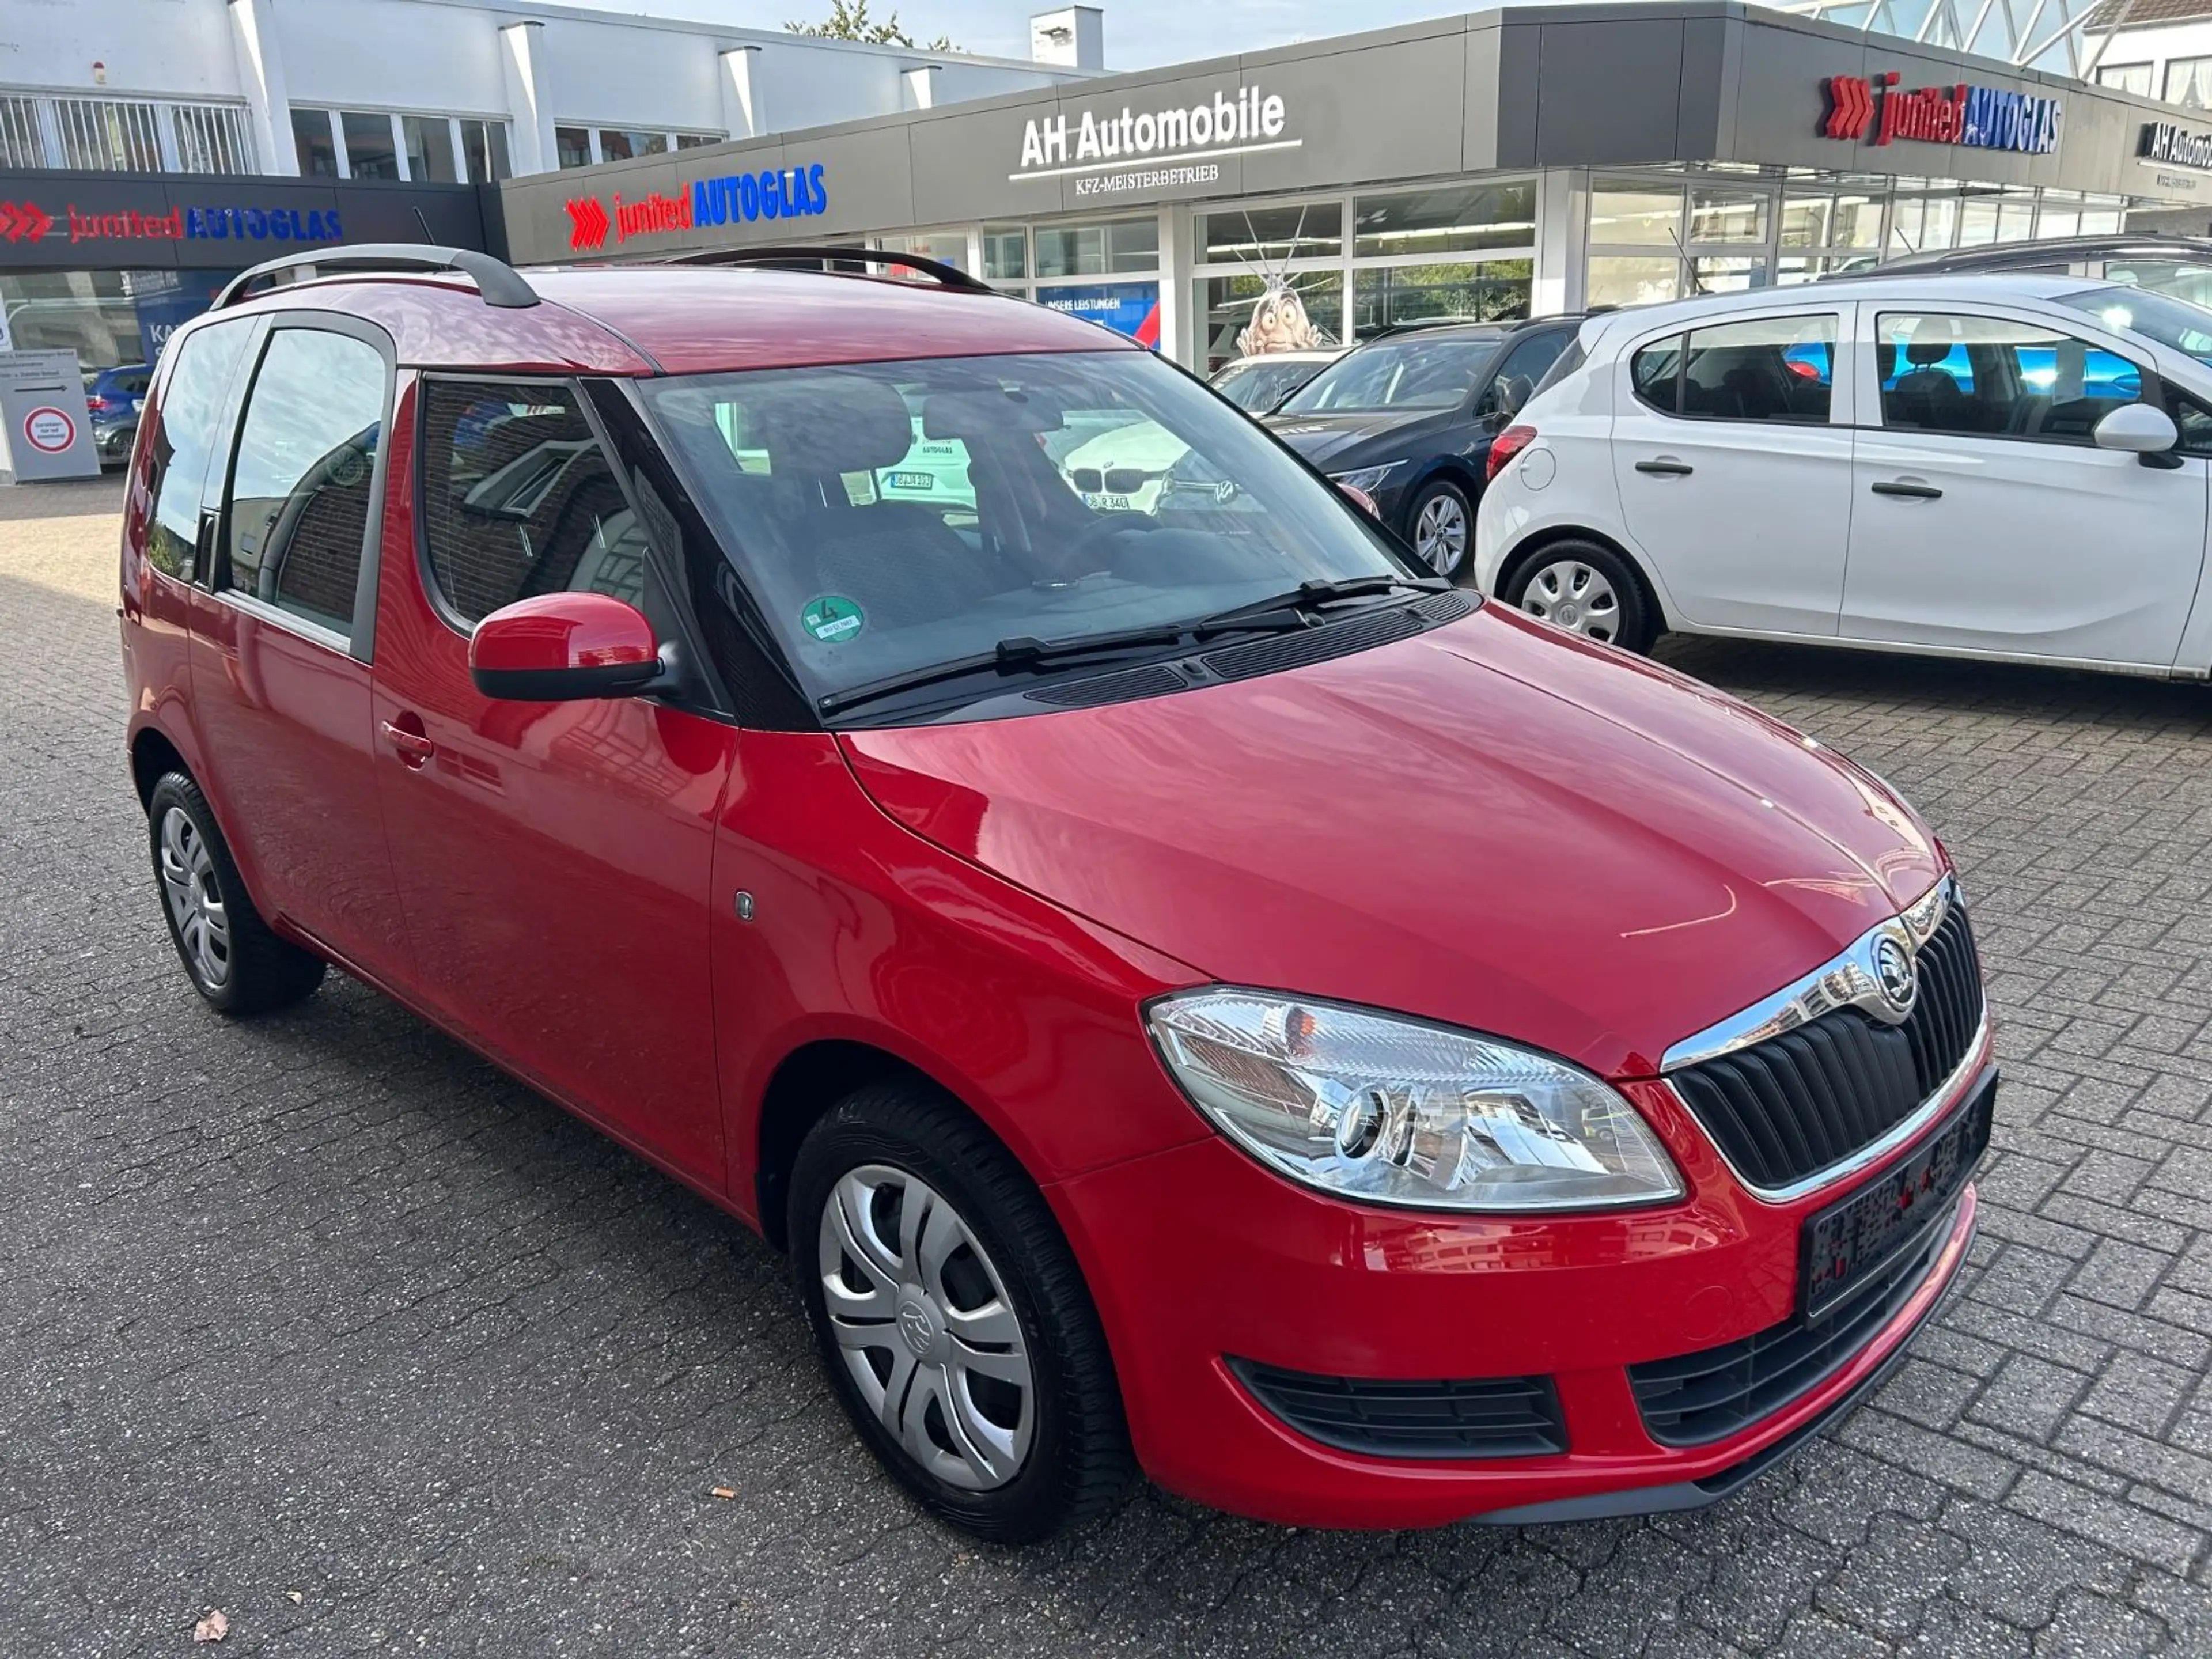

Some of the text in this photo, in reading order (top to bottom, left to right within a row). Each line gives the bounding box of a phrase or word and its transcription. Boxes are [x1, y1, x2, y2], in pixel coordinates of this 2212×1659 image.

[1020, 85, 1285, 167] AH Automobile
[1877, 72, 2061, 153] junited AUTOGLAS
[2151, 122, 2212, 168] AH Automo
[1075, 164, 1219, 195] KFZ-MEISTERBETRIEB
[67, 204, 343, 244] junited AUTOGLAS
[615, 164, 828, 244] junited AUTOGLAS
[1074, 297, 1120, 310] LEISTUNGEN
[821, 600, 838, 619] 4
